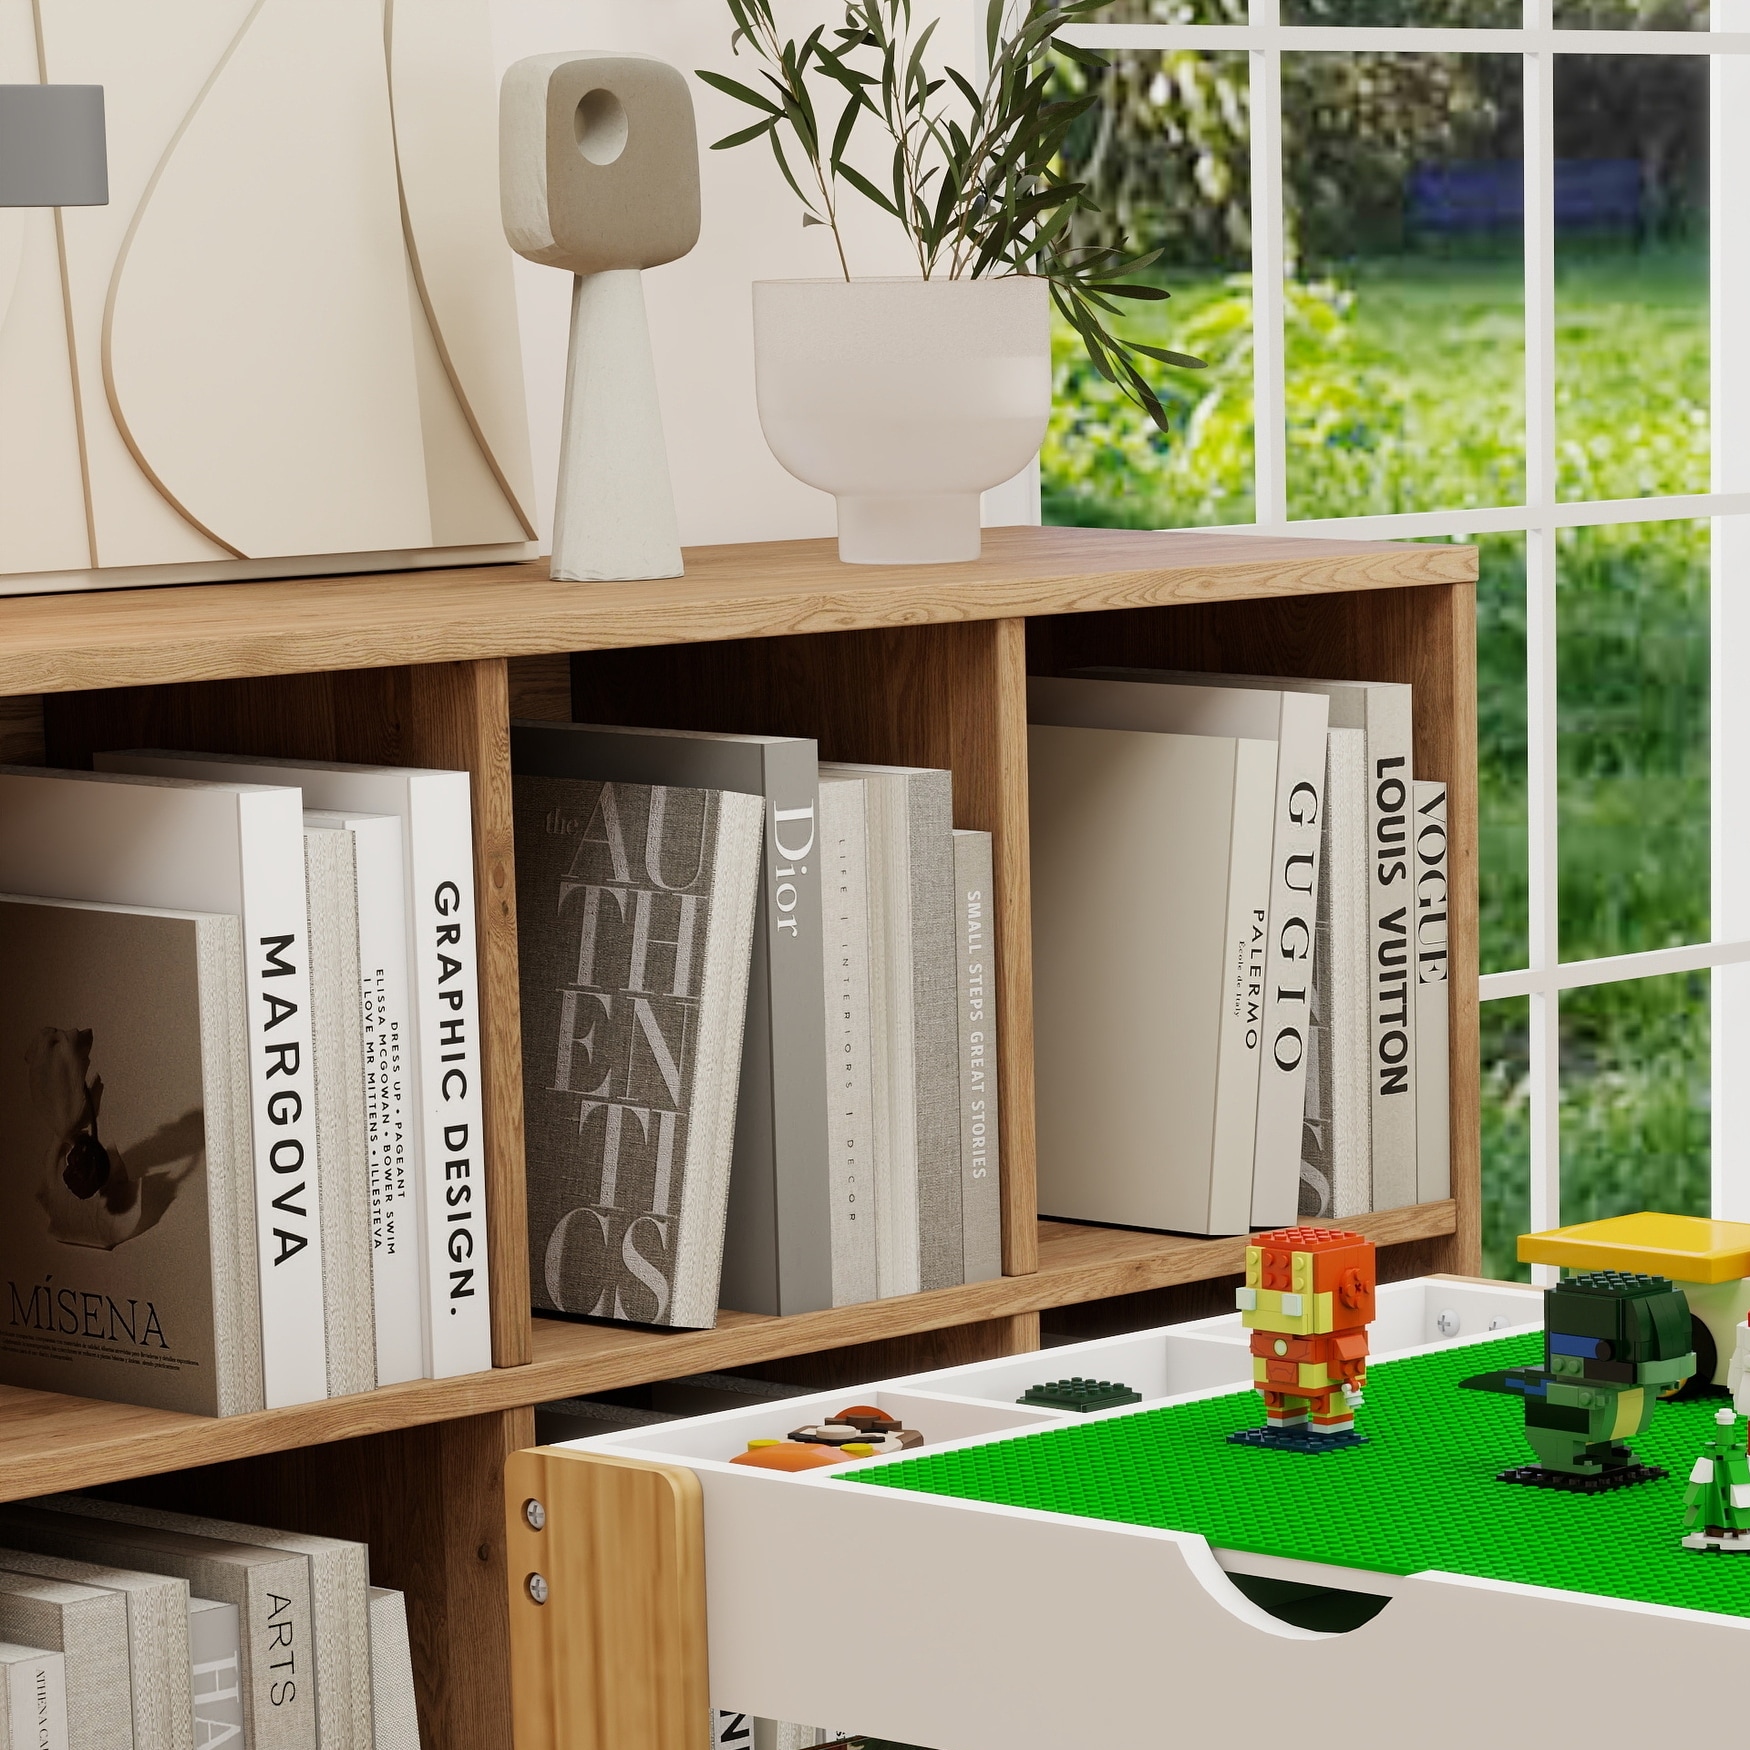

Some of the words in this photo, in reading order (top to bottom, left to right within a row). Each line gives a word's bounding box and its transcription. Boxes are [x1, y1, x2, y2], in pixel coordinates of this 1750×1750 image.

[1376, 757, 1406, 886] LOUIS
[773, 798, 815, 938] Dior
[839, 838, 848, 893] LIFE
[1416, 791, 1448, 985] VOGUE
[967, 889, 982, 954] SMALL
[1274, 781, 1318, 1073] GUGIO
[364, 991, 373, 1033] LOVE
[376, 968, 386, 1026] ELISSA
[434, 881, 468, 1102] GRAPHIC
[842, 943, 853, 1090] INTERIORS
[969, 963, 984, 1022] STEPS
[1236, 976, 1242, 988] de
[1245, 908, 1265, 1051] PALERMO
[1378, 907, 1409, 1096] VUITTON
[366, 1042, 375, 1064] MR
[379, 1034, 390, 1124] MCGOWAN
[390, 1022, 400, 1073] DRESS
[970, 1031, 985, 1093] GREAT
[260, 933, 309, 1267] MARGOVA
[368, 1073, 378, 1142] MITTENS
[393, 1081, 401, 1101] UP
[384, 1144, 393, 1203] BOWER
[395, 1122, 406, 1198] PAGEANT
[971, 1099, 987, 1180] STORIES
[371, 1163, 382, 1249] ILLESTEVA
[847, 1138, 856, 1222] DECOR
[386, 1211, 396, 1255] SWIM
[443, 1123, 475, 1316] DESIGN.
[8, 1275, 170, 1349] MÍSENA
[266, 1592, 296, 1707] ARTS
[36, 1669, 48, 1725] ATHENA
